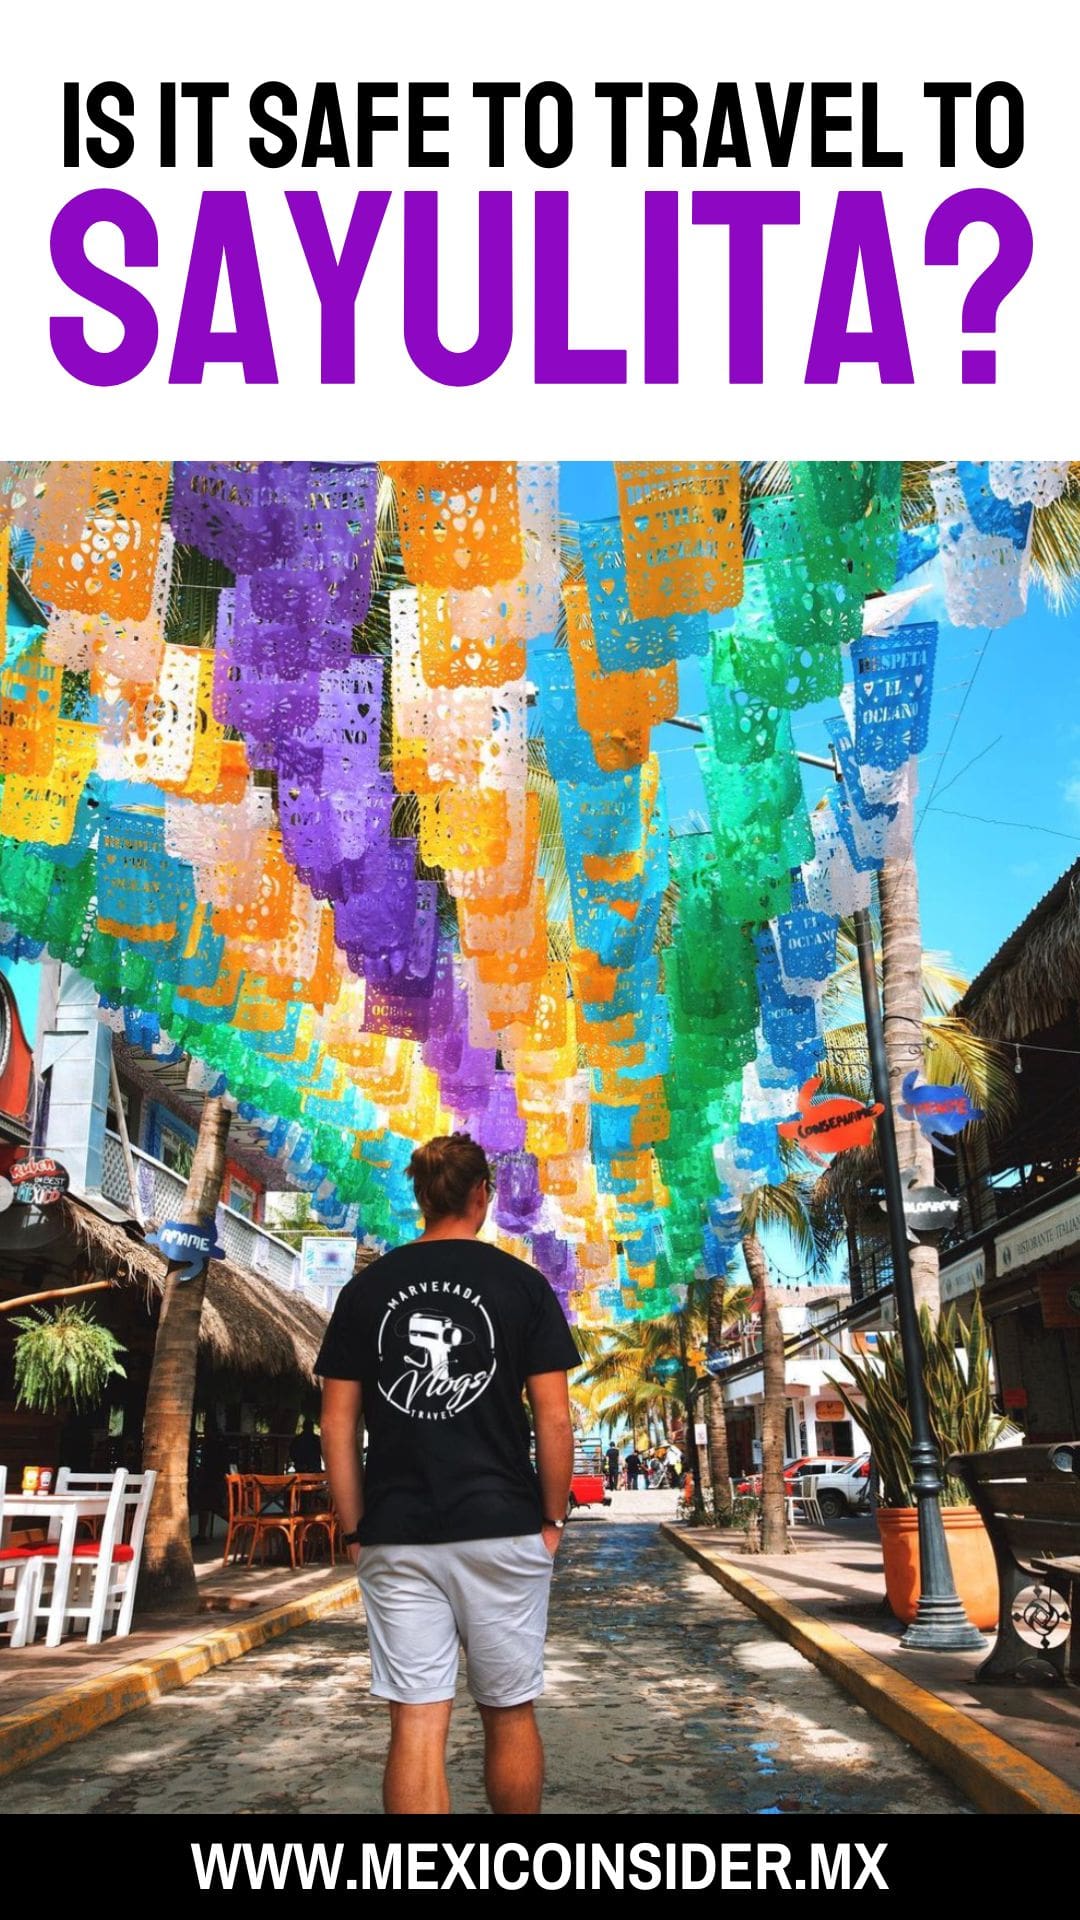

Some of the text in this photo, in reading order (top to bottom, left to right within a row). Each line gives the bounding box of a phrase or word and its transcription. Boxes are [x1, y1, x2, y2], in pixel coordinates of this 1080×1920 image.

[859, 649, 926, 674] RESPETA
[885, 680, 902, 697] EL
[863, 702, 918, 725] OCEANO
[161, 1228, 209, 1252] AMAME
[387, 1281, 481, 1310] MARVEKADA
[386, 1359, 489, 1411] Vlogs
[411, 1409, 455, 1420] TRAVEL
